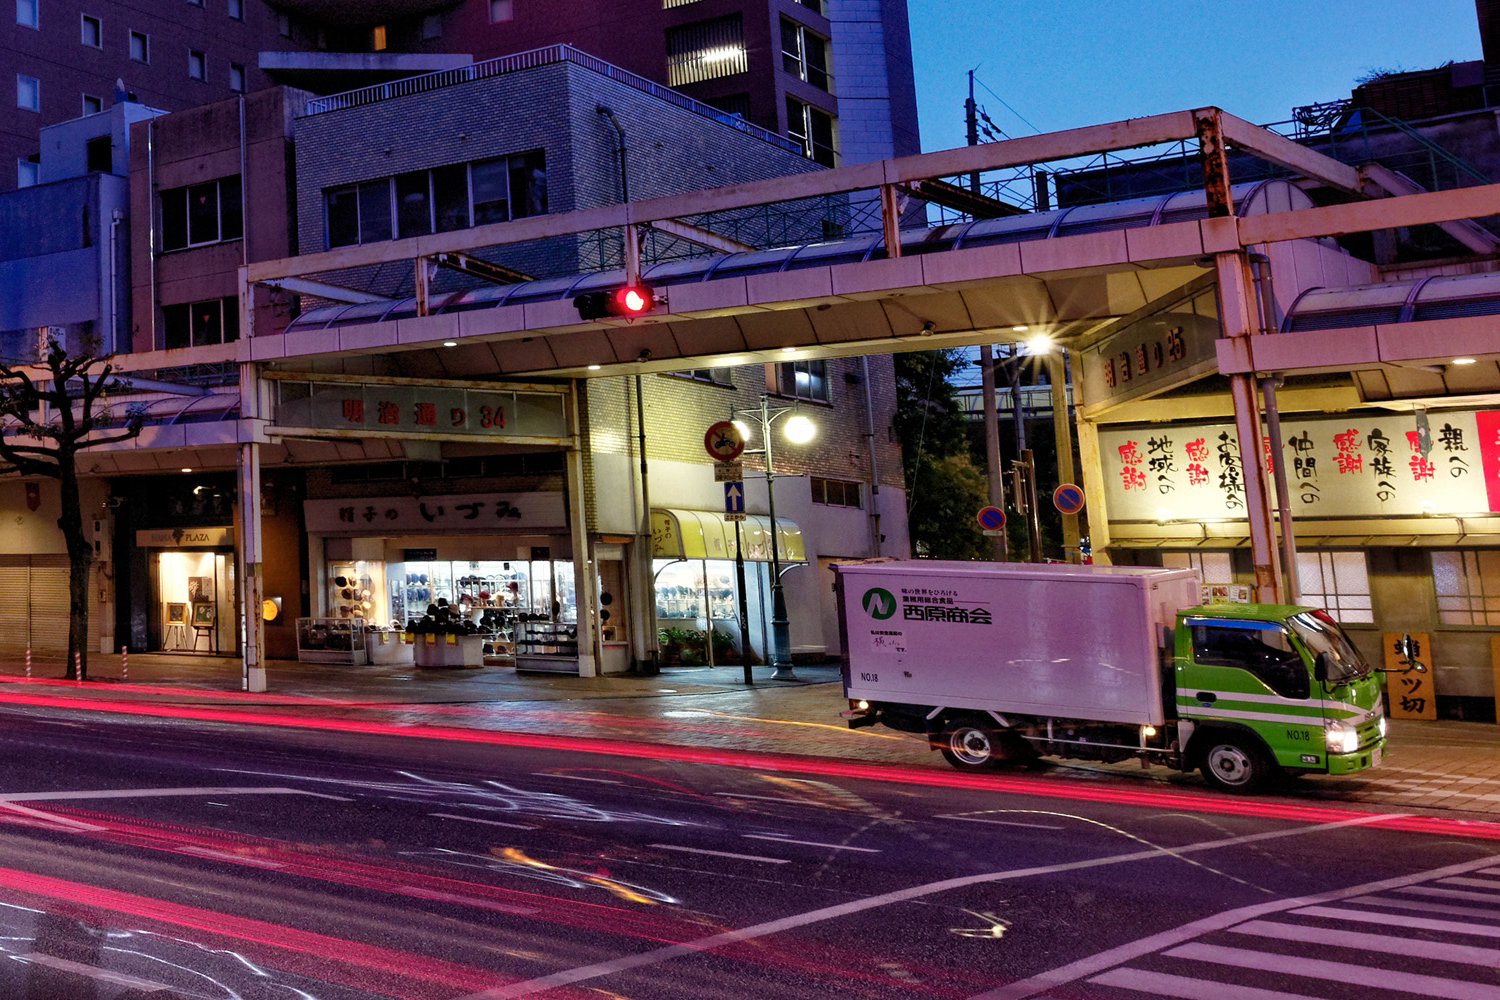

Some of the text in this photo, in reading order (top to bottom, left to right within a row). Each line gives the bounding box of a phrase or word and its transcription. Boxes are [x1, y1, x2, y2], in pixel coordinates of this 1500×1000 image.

[342, 399, 506, 429] 明治通り34
[1117, 440, 1147, 492] 感謝
[1147, 435, 1179, 495] 地域への
[1185, 437, 1211, 487] 感謝
[1288, 430, 1320, 504] 仲間への
[1332, 428, 1363, 475] 感謝
[1367, 428, 1397, 502] 家族への
[419, 501, 522, 523] いづみ
[185, 533, 210, 542] PLAZA
[903, 604, 993, 625] 西原商会
[861, 672, 879, 683] NO.18
[1286, 729, 1310, 742] NO.18
